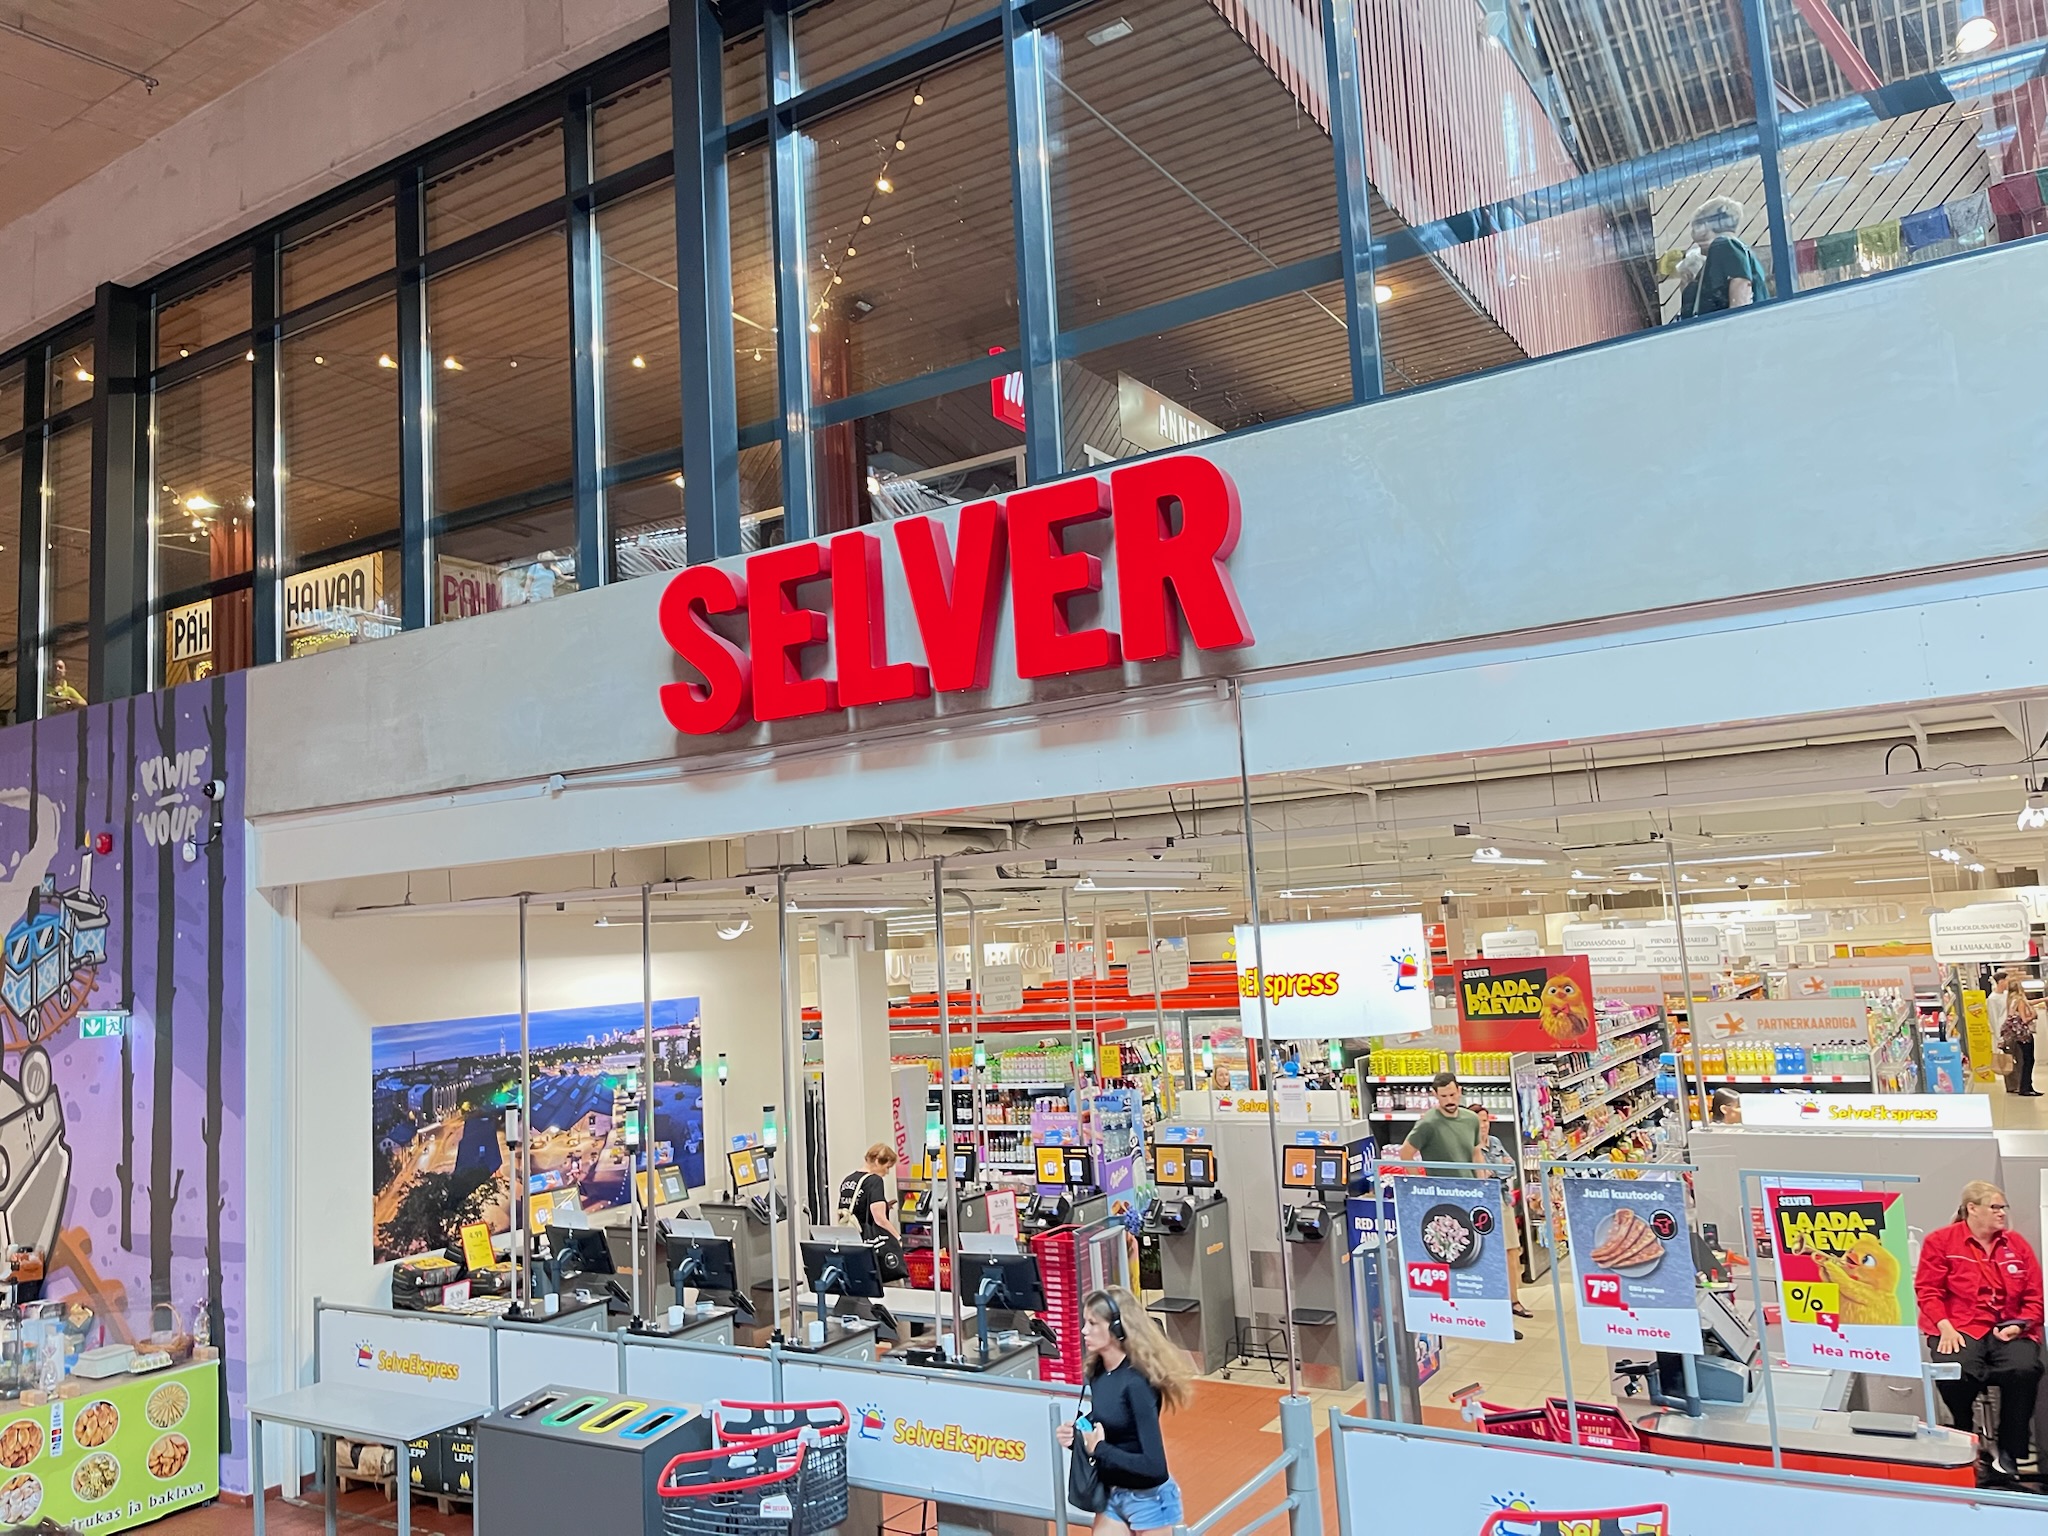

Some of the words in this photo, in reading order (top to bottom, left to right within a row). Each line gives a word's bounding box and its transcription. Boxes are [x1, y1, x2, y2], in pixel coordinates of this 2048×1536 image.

[659, 455, 1255, 735] SELVER
[140, 748, 206, 797] KIWIE
[1462, 968, 1490, 979] SELVER
[1464, 979, 1540, 1000] LAADA-
[1466, 996, 1543, 1015] PÄEVAD
[1757, 1017, 1857, 1030] PARTNERKAARDIGA
[892, 1097, 904, 1133] Red
[1828, 1105, 1938, 1124] SelveEkspress
[1411, 1185, 1435, 1196] Juuli
[1436, 1186, 1484, 1198] kuutoode
[1582, 1188, 1609, 1200] Juuli
[1611, 1189, 1665, 1201] kuutoode
[1778, 1196, 1812, 1206] SELVER
[1354, 1217, 1374, 1230] RED
[1780, 1211, 1876, 1231] LAADA-
[1791, 1285, 1823, 1313] %
[1430, 1312, 1453, 1324] Hea
[1456, 1315, 1486, 1328] mõte
[1607, 1323, 1633, 1335] Hea
[1637, 1326, 1671, 1339] mõte
[1812, 1343, 1843, 1357] Hea
[1849, 1347, 1891, 1362] mõte
[377, 1349, 460, 1382] SelveEkspress
[892, 1417, 1027, 1462] SelveEkspress
[127, 1501, 142, 1517] ja
[149, 1482, 205, 1509] baklava
